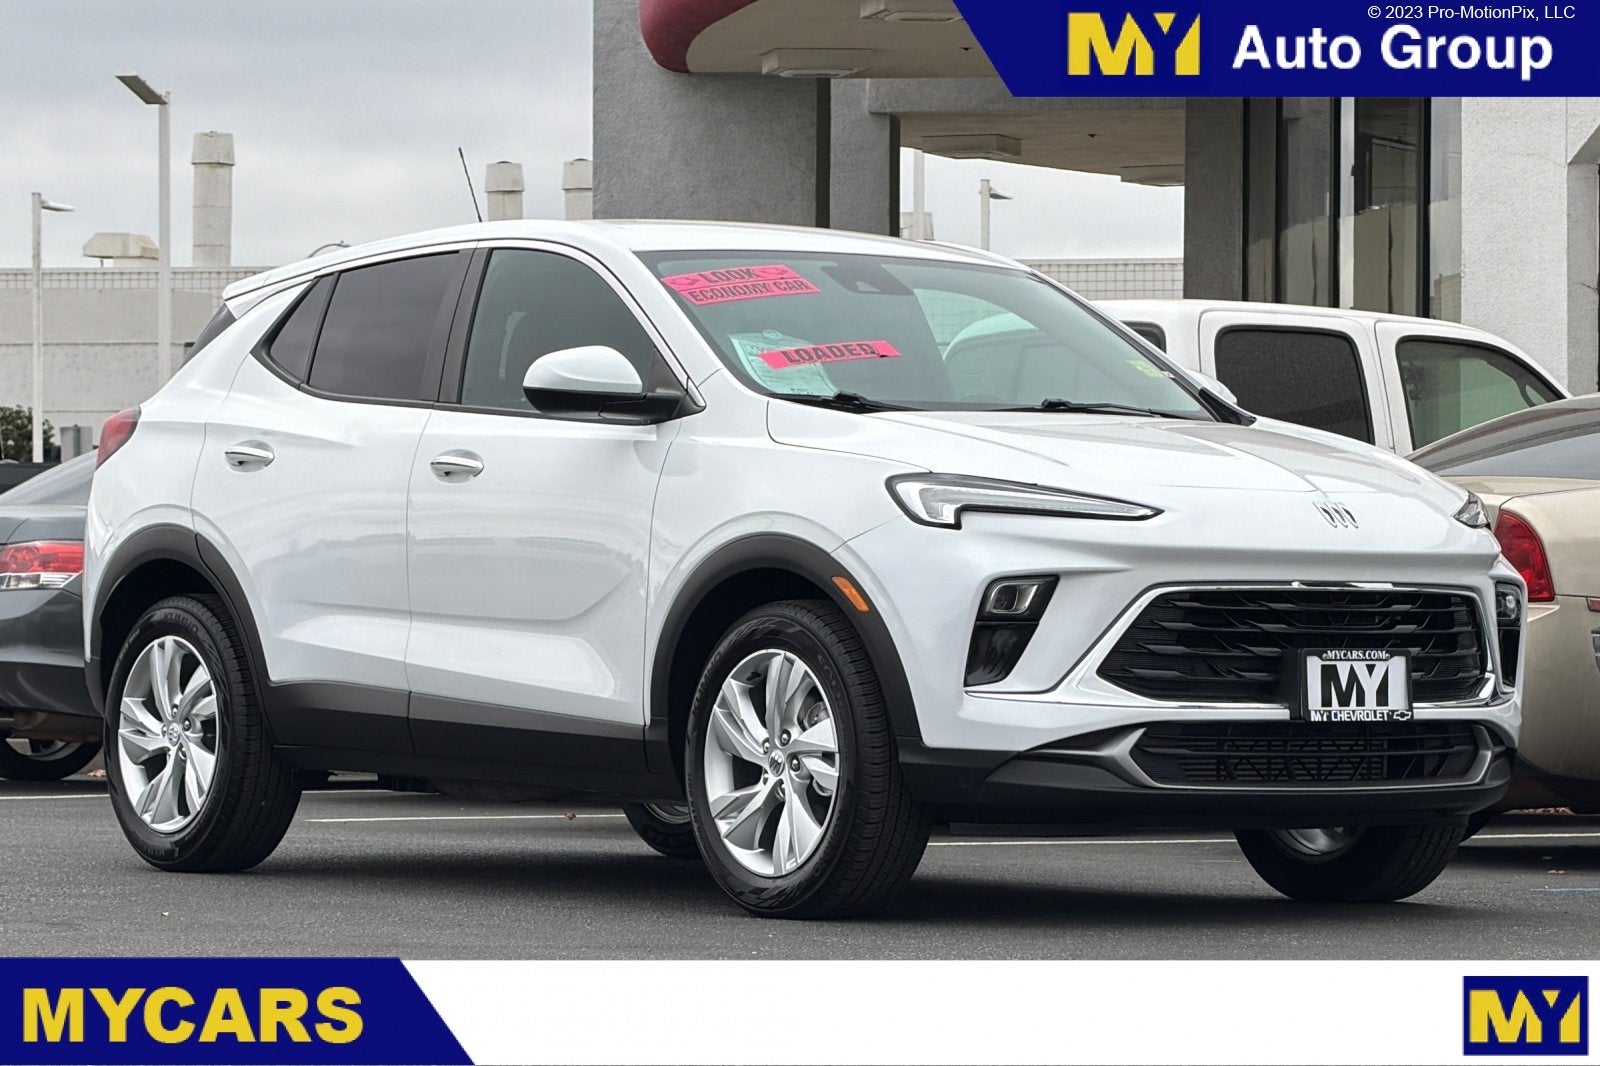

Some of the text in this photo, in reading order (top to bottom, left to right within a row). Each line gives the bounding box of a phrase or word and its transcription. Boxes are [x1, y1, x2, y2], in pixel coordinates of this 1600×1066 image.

[699, 267, 762, 284] LOOK
[688, 280, 810, 302] ECONOMY CAR
[780, 343, 876, 363] LOADED
[1327, 650, 1386, 660] MYCARS.COM
[1320, 663, 1389, 708] MY
[1331, 710, 1389, 721] CHEVROLET
